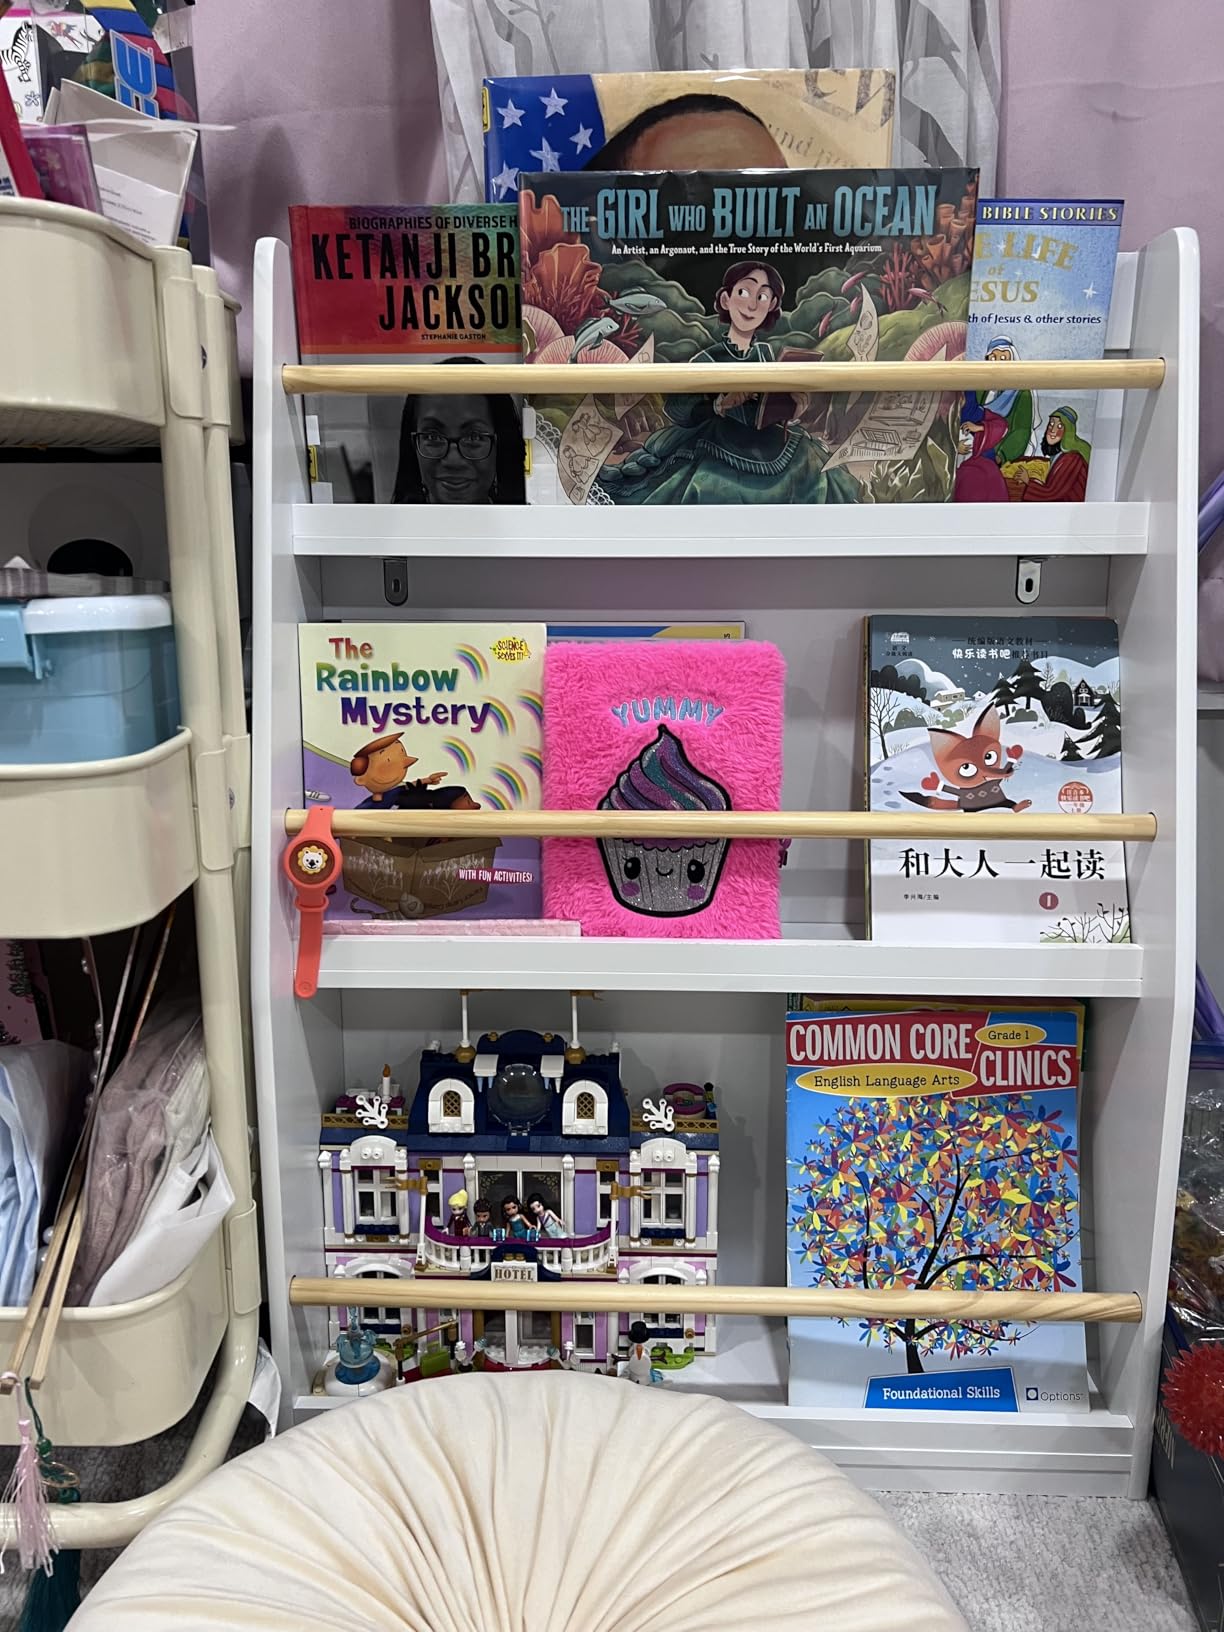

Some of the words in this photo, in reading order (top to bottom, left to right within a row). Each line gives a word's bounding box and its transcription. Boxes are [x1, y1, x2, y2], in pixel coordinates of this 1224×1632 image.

[561, 206, 590, 233] THE
[597, 187, 664, 240] GIRL
[668, 204, 705, 232] WHO
[712, 186, 800, 239] BUILT
[805, 203, 828, 231] AN
[833, 185, 937, 237] OCEAN
[982, 206, 1032, 220] BIBLE
[1039, 206, 1118, 221] STORIES
[350, 216, 432, 230] BIOGRAPHIES
[435, 216, 450, 230] OF
[453, 215, 506, 229] DIVERSE
[312, 232, 457, 280] KETANJI
[472, 231, 516, 279] BR
[611, 244, 622, 255] An
[623, 244, 649, 256] Artist,
[650, 246, 659, 255] an
[660, 244, 698, 257] Argonaut,
[699, 243, 714, 254] and
[715, 243, 728, 254] the
[729, 243, 747, 254] True
[748, 243, 769, 257] Story
[770, 242, 779, 254] of
[780, 242, 793, 253] the
[794, 242, 823, 253] World's
[824, 242, 843, 253] First
[845, 242, 883, 256] Aquarium
[1002, 231, 1080, 271] LIFE
[987, 264, 1004, 276] of
[981, 313, 994, 323] of
[993, 314, 1021, 324] Jesus
[1024, 314, 1032, 323] &
[1036, 314, 1064, 323] other
[1066, 313, 1101, 323] stories
[421, 333, 458, 341] STEPHANIE
[459, 333, 486, 341] GASTON
[328, 637, 373, 659] The
[497, 640, 524, 651] SCIENCE
[315, 662, 459, 692] Rainbow
[341, 697, 491, 733] Mystery
[611, 696, 725, 728] YUMMY
[898, 847, 1106, 881] 和大人一起读
[458, 868, 477, 881] WITH
[478, 870, 492, 882] FUN
[493, 869, 533, 883] ACTIVITIES!
[789, 1023, 900, 1061] COMMON
[909, 1023, 972, 1060] CORE
[988, 1030, 1022, 1041] Grade
[1024, 1030, 1030, 1040] 1
[980, 1049, 1072, 1087] CLINICS
[814, 1074, 861, 1089] English
[865, 1074, 927, 1088] Language
[931, 1074, 960, 1087] Arts
[495, 1268, 533, 1280] HOTEL
[883, 1386, 962, 1400] Foundational
[966, 1386, 1001, 1399] Skills
